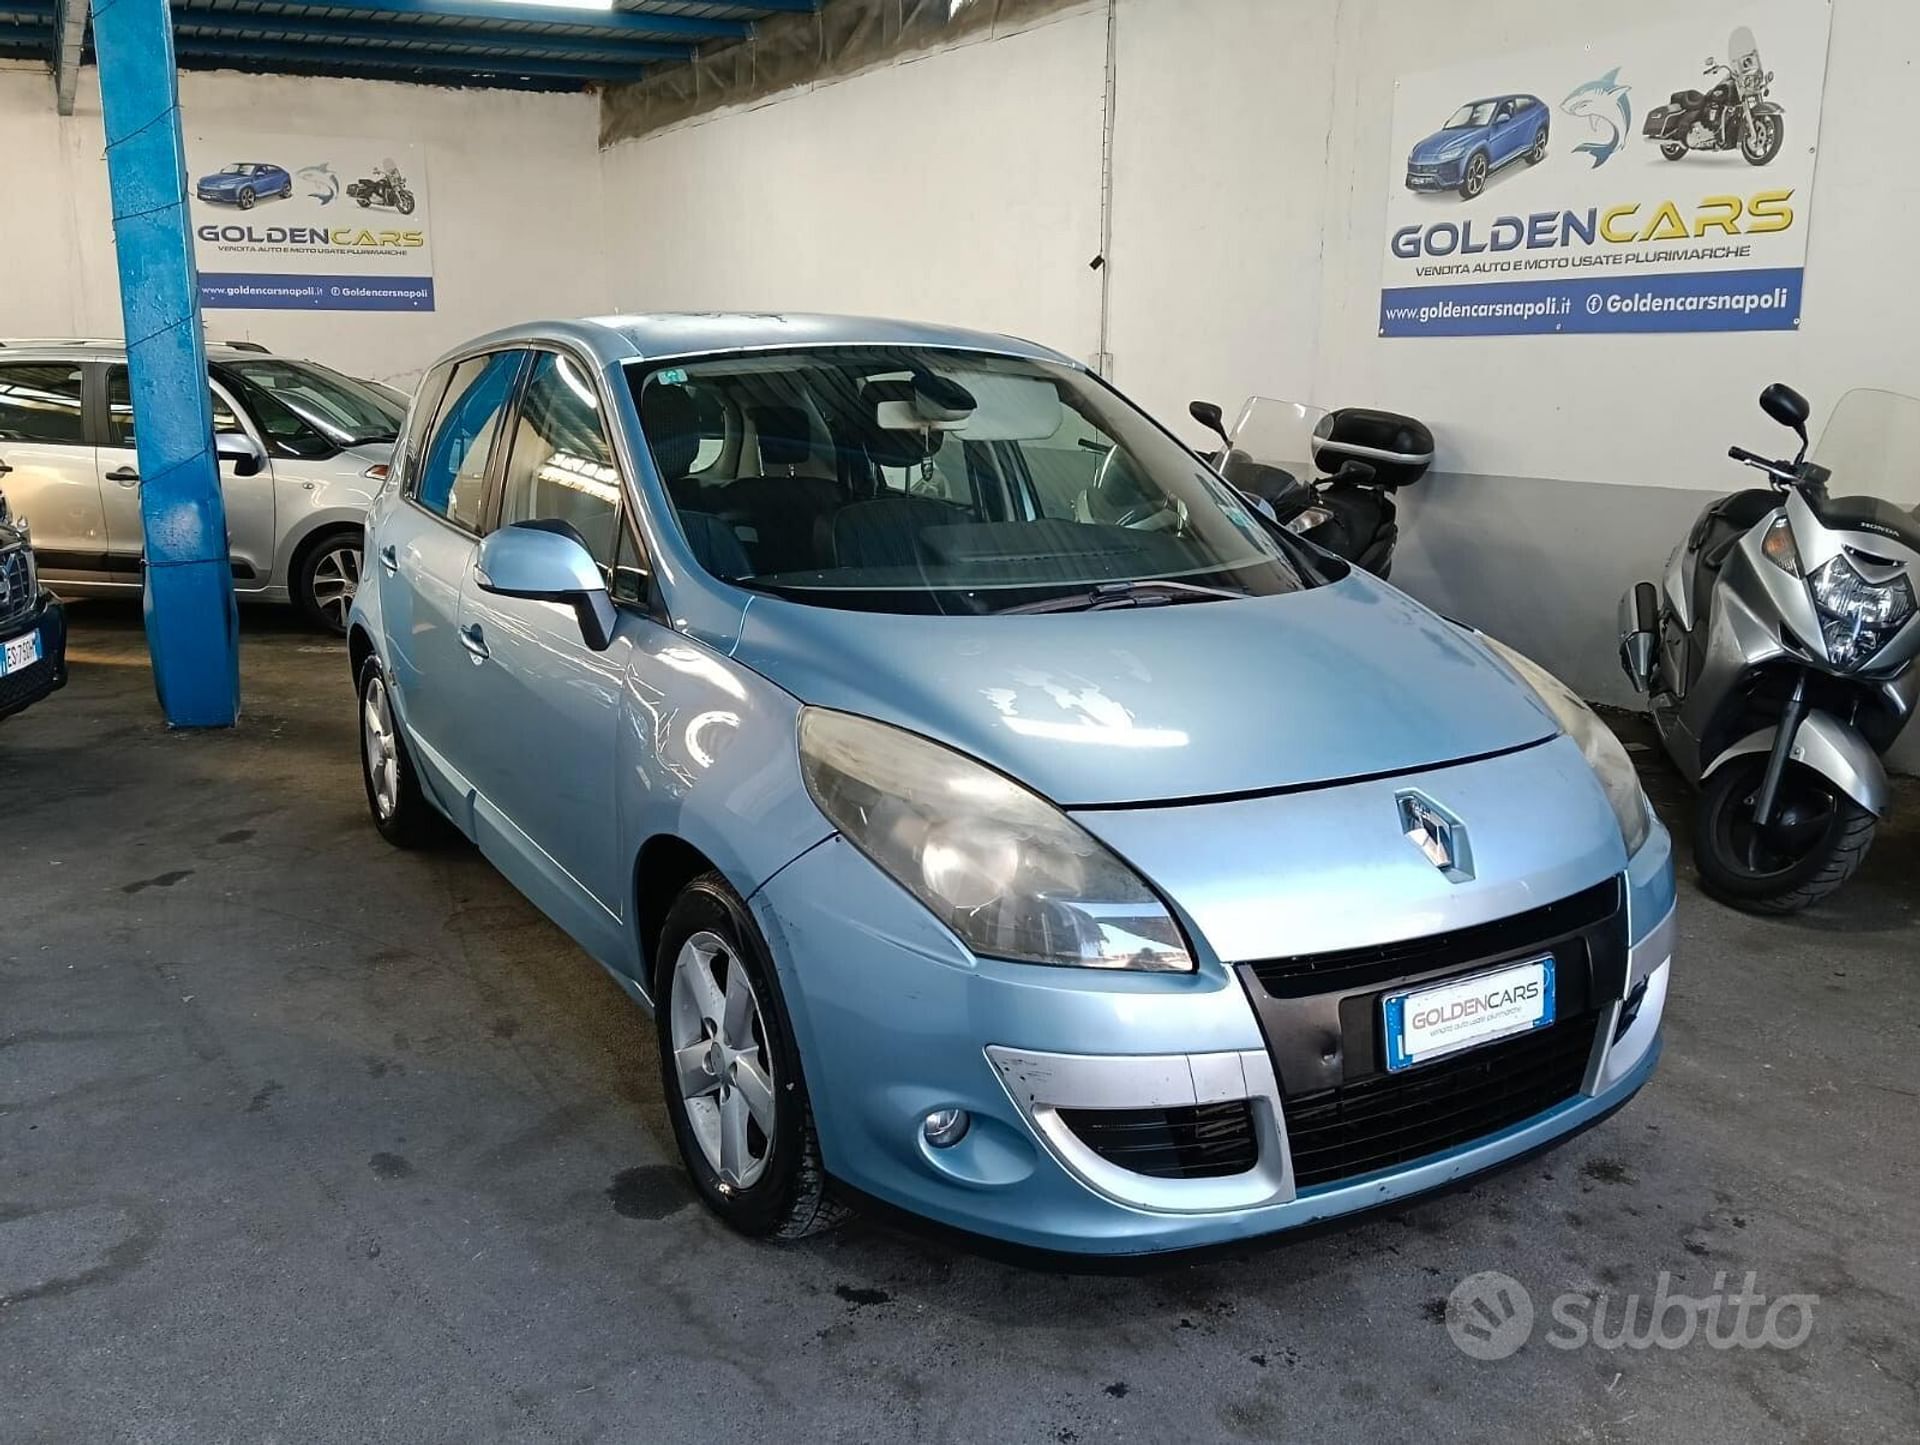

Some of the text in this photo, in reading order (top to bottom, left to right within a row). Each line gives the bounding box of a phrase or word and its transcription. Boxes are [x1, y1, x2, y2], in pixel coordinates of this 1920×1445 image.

[198, 225, 424, 247] GOLDENCARS
[1391, 188, 1796, 258] GOLDENCARS
[1416, 245, 1751, 277] VENDITA AUTO E MOTO USATE PLURIMARCHE
[201, 286, 428, 298] www.goldencarsnapoli.it Goldencarsnapoli
[1385, 297, 1571, 322] www.goldencarsnapoli.it
[1606, 288, 1788, 314] Goldencarsnapoli
[1861, 522, 1900, 537] HONDA
[1412, 981, 1539, 1030] GOLDENCARS
